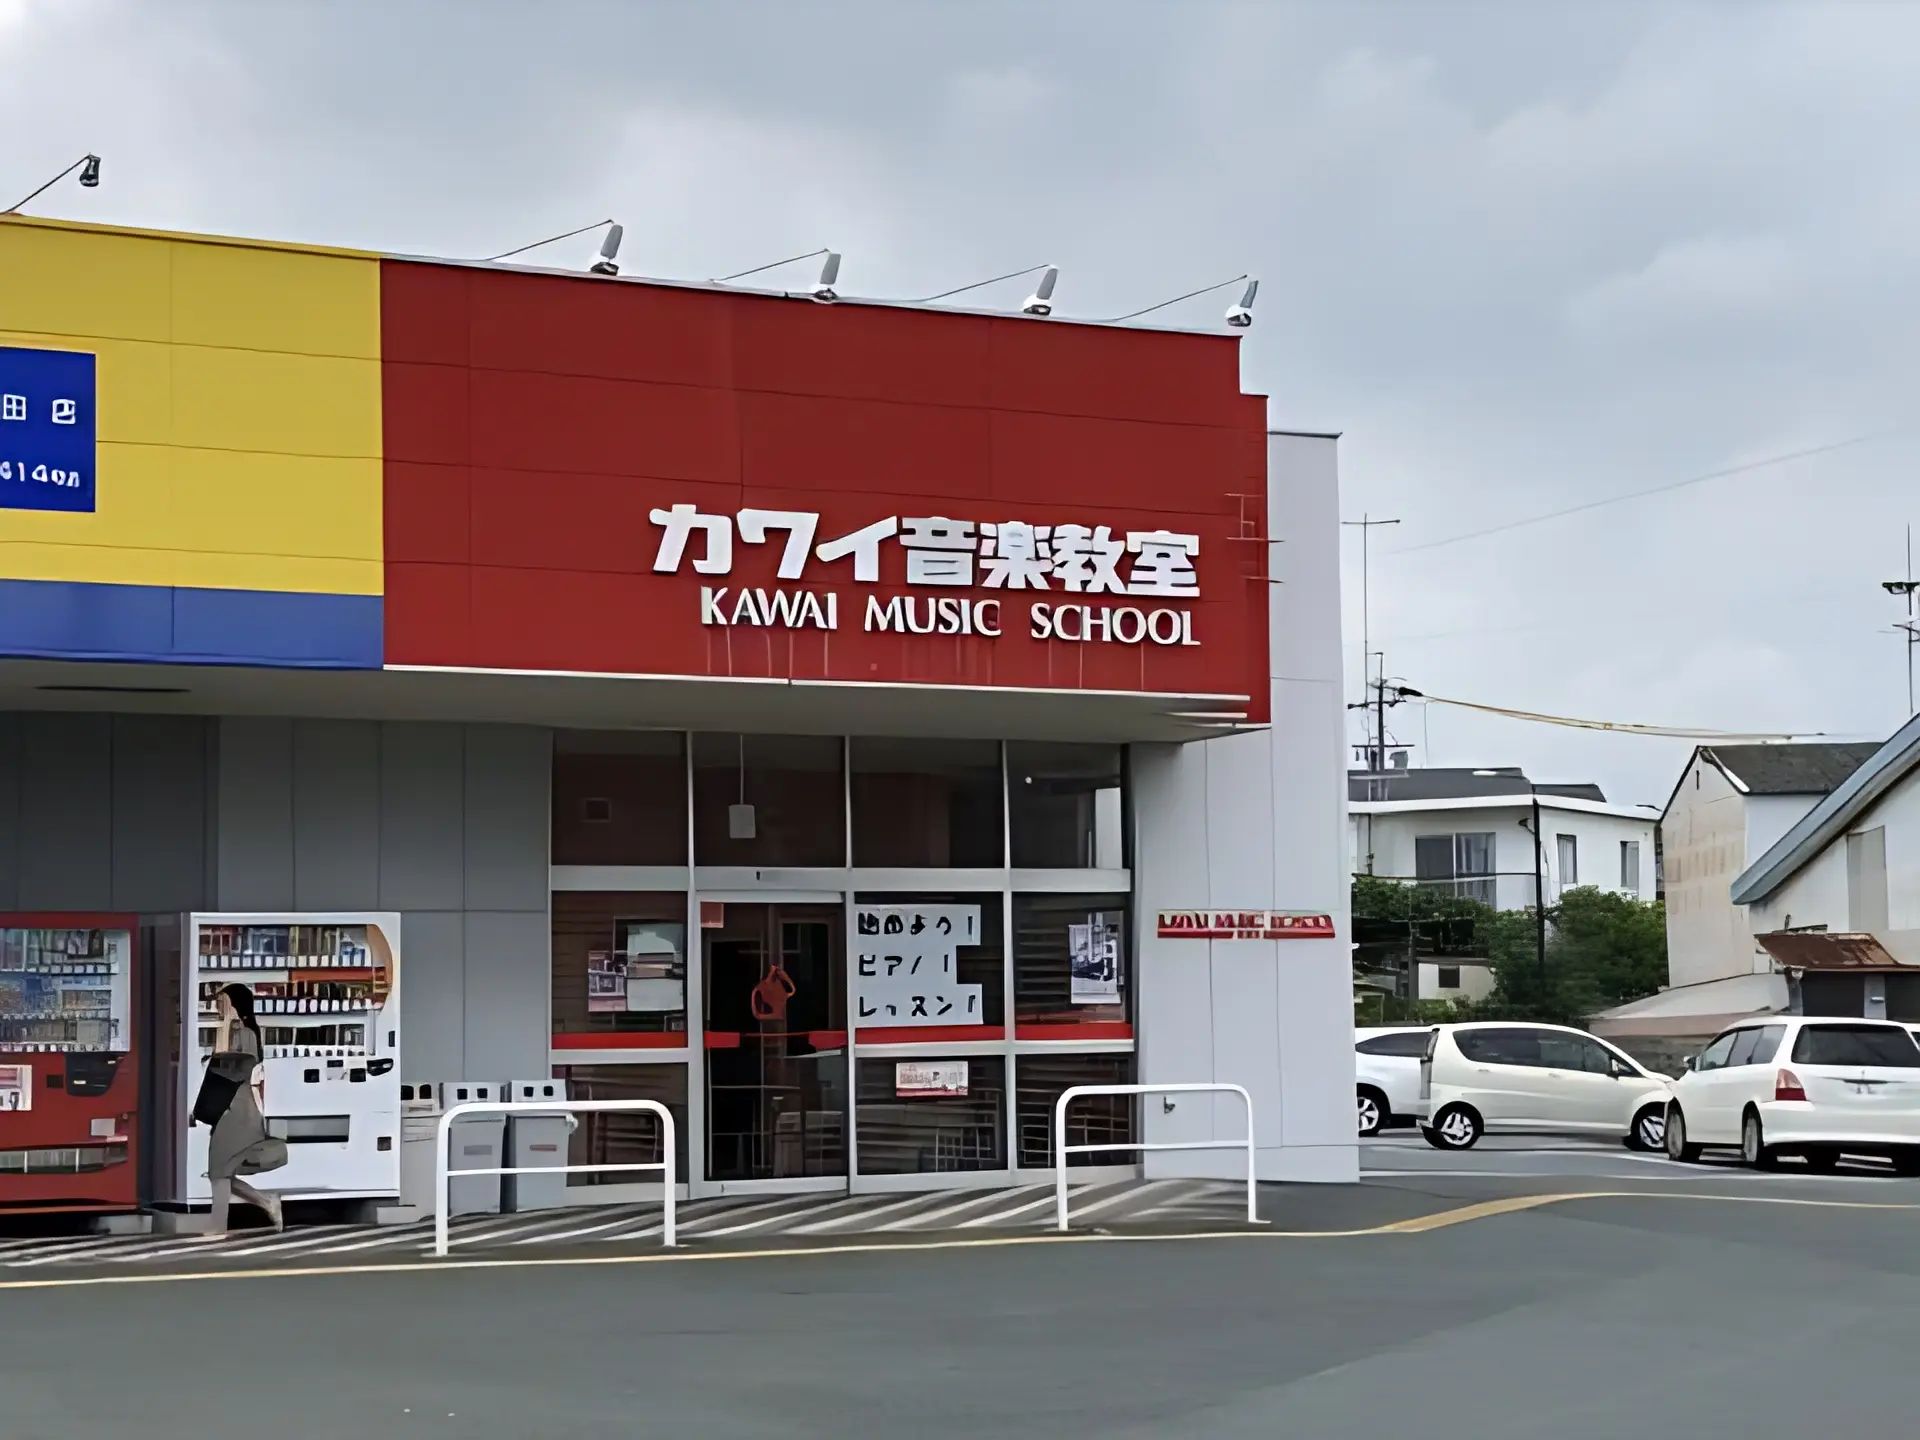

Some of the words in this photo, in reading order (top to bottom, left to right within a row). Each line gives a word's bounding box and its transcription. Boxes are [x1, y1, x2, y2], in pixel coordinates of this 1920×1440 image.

[649, 503, 1201, 598] カワイ音楽教室
[701, 586, 838, 631] KAWAI
[864, 595, 1002, 637] MUSIC
[1030, 602, 1201, 647] SCHOOL
